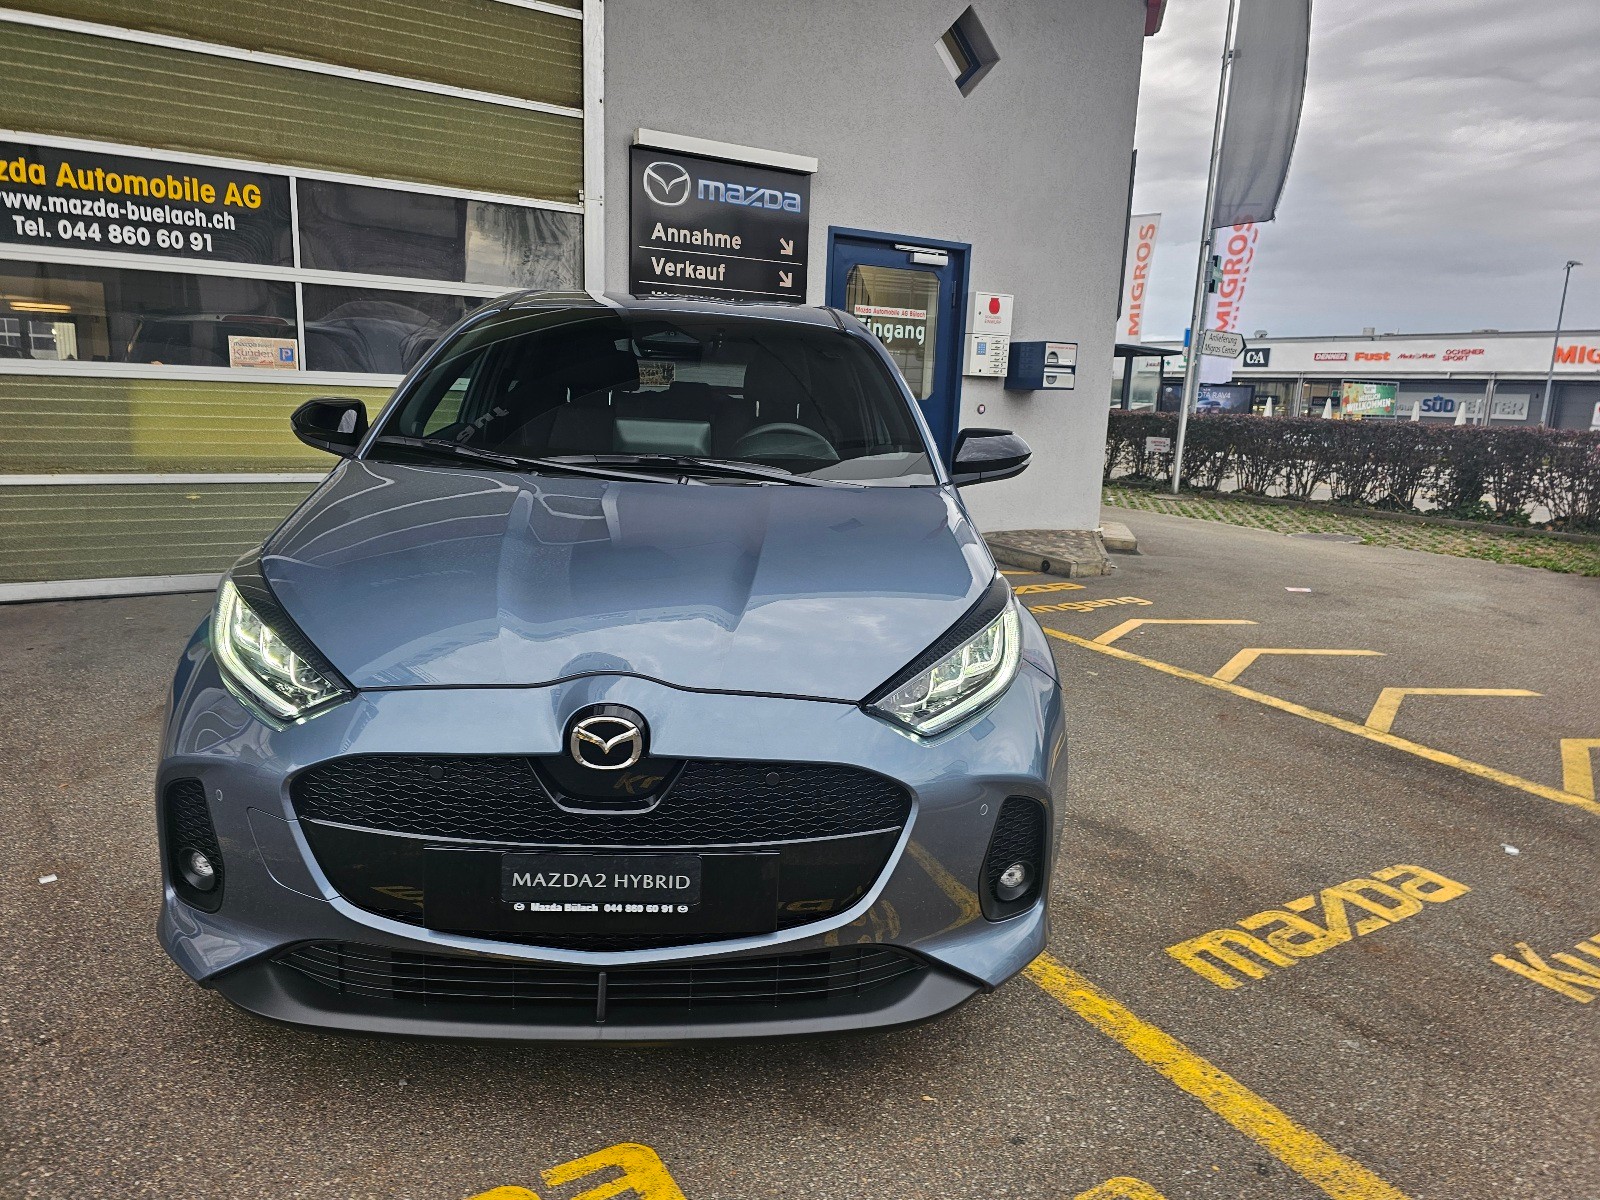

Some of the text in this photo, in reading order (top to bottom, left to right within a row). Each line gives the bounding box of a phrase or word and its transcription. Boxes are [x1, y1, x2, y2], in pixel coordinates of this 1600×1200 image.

[56, 162, 216, 204] Automobile
[223, 182, 262, 209] AG
[697, 178, 801, 213] mazda
[0, 190, 236, 231] ww.mazda-buelach.ch
[12, 215, 213, 252] Tel. 044 860 60 91
[651, 222, 742, 249] Annahme
[651, 256, 726, 281] Verkauf
[1215, 214, 1255, 331] MIGROS
[1128, 223, 1156, 336] MIGROS
[855, 306, 872, 314] Mazda
[873, 307, 900, 316] Automobile
[1205, 343, 1237, 355] Migros Center
[1209, 333, 1238, 346] Anlieferung
[1246, 351, 1265, 364] C&A
[1354, 352, 1391, 361] Fust
[1212, 391, 1231, 399] RAV4
[1346, 398, 1391, 411] WILLKOMMEN
[512, 872, 691, 890] MAZDA2 HYBRID
[530, 902, 674, 913] Mazda Bülach 044 860 60 91
[1164, 865, 1471, 990] mazda
